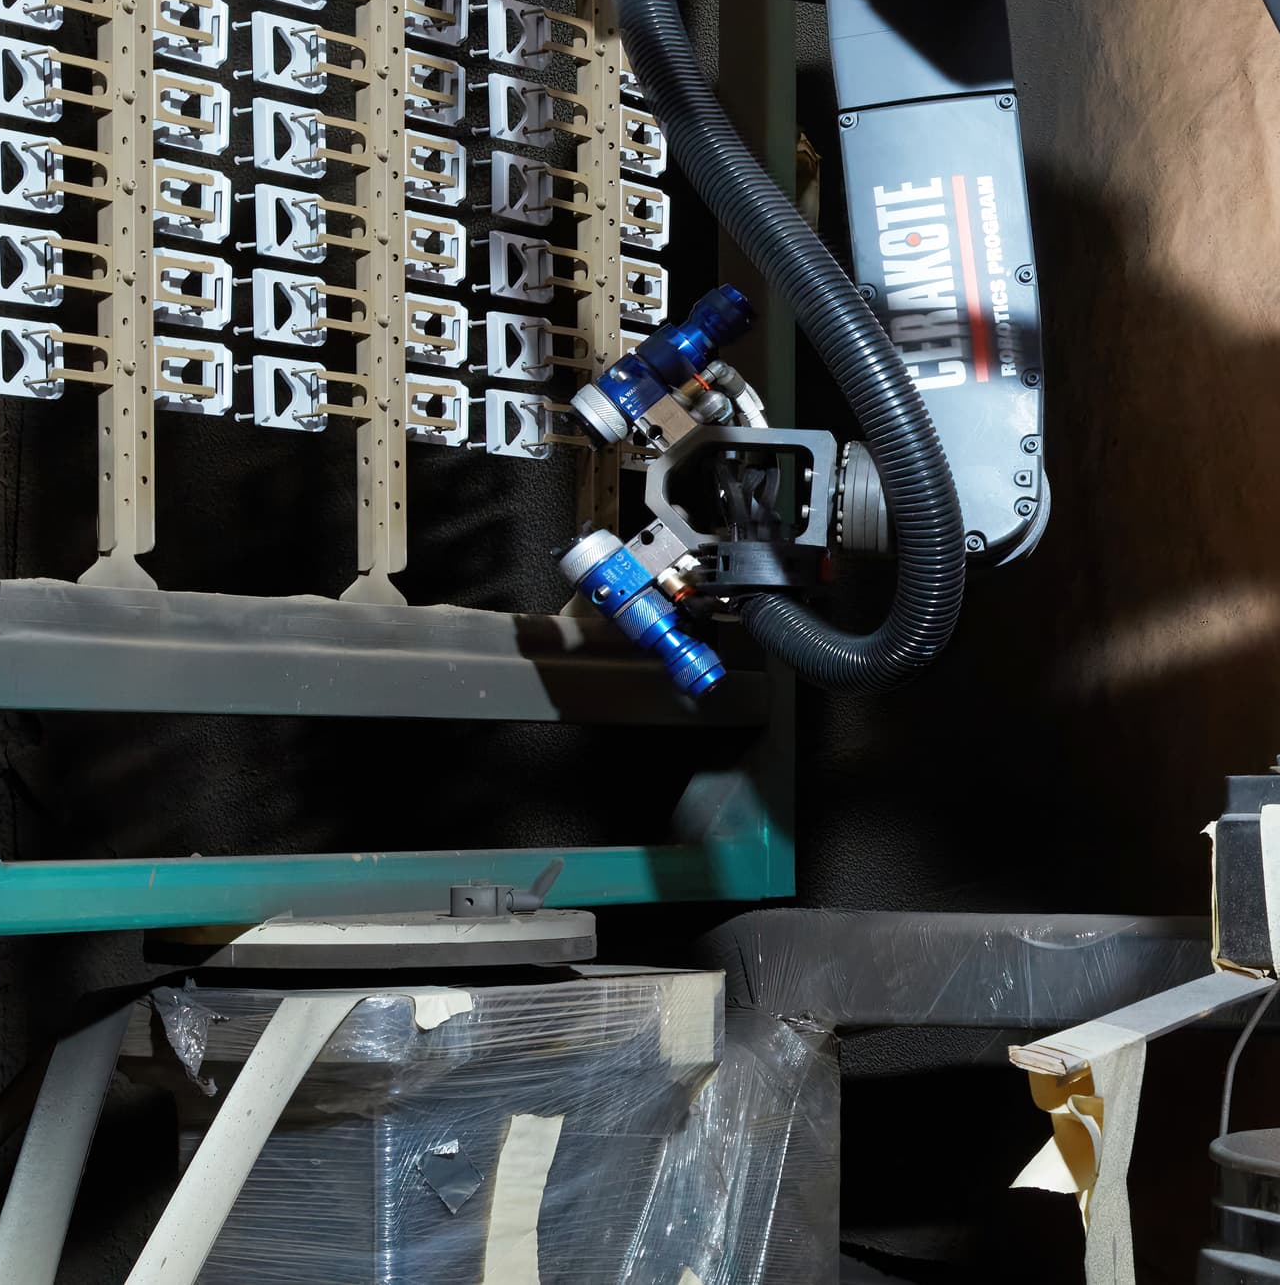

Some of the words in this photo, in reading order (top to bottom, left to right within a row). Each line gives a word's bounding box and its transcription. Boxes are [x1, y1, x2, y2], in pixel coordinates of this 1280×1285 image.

[976, 175, 1005, 275] PROGRAM
[873, 177, 967, 392] CERAKOTE
[990, 278, 1017, 378] ROBOTICS
